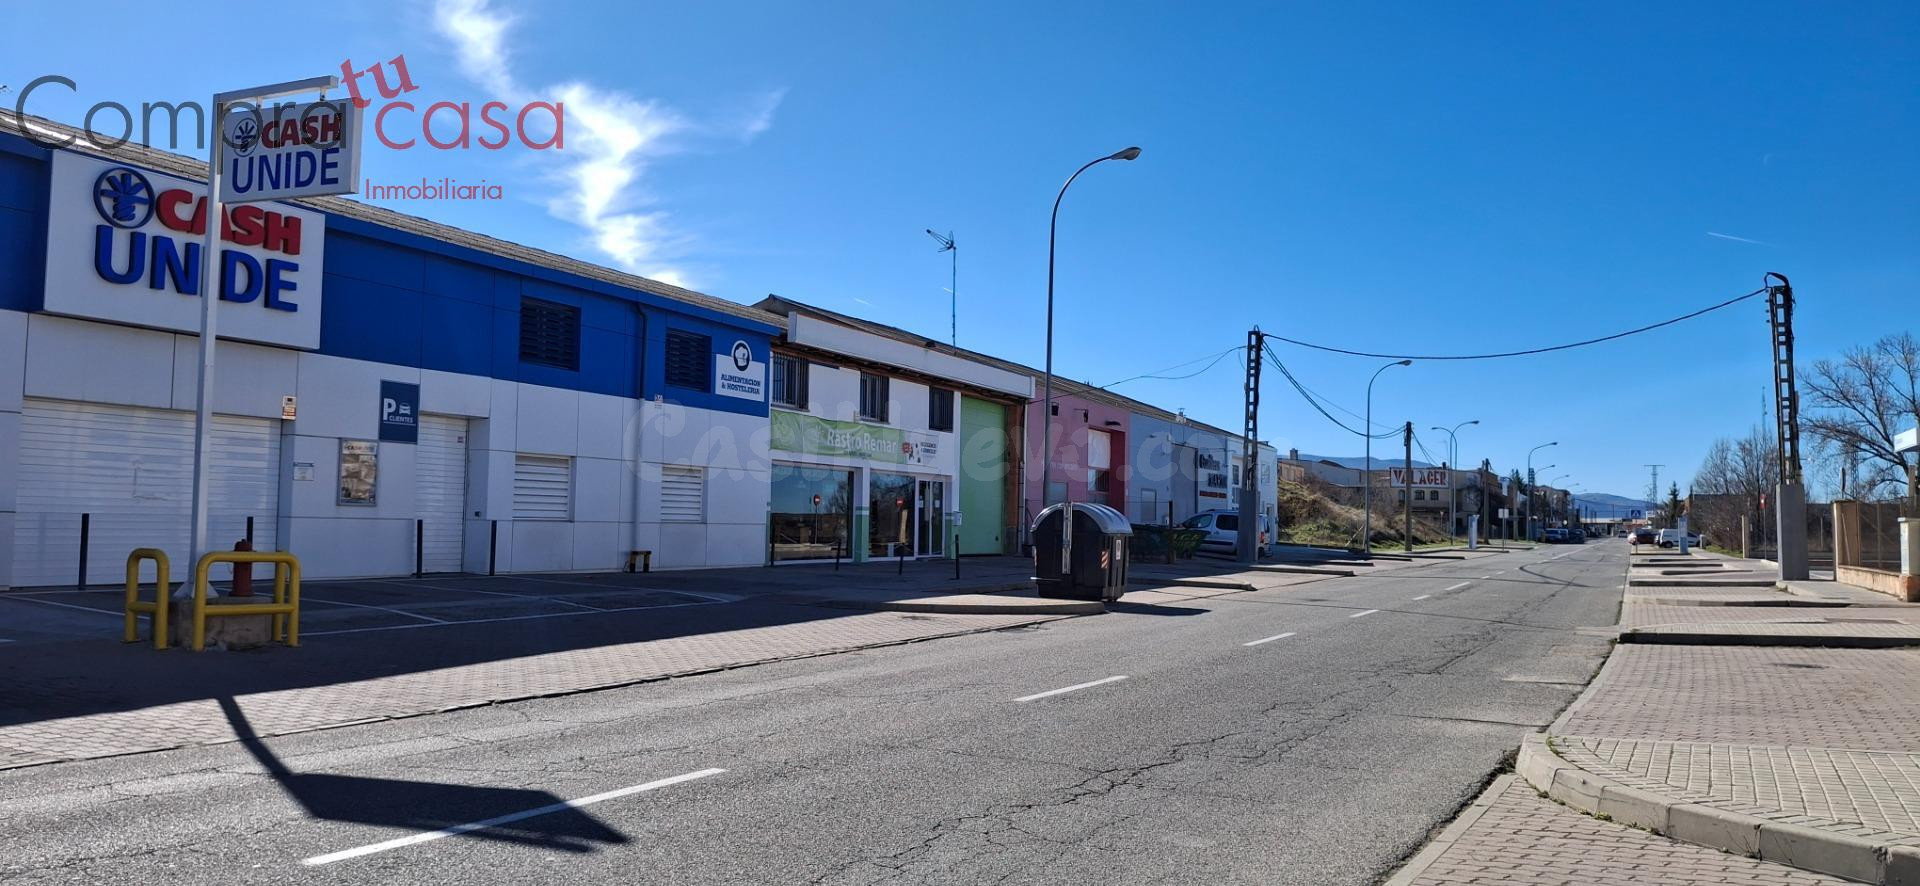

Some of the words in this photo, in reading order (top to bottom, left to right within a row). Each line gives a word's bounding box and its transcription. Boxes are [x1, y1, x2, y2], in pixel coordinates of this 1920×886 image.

[261, 113, 342, 149] CASH
[232, 148, 339, 194] UNIDE
[95, 224, 299, 312] UNDE
[383, 397, 396, 420] P
[827, 428, 862, 450] Rastro
[864, 433, 897, 453] Remar
